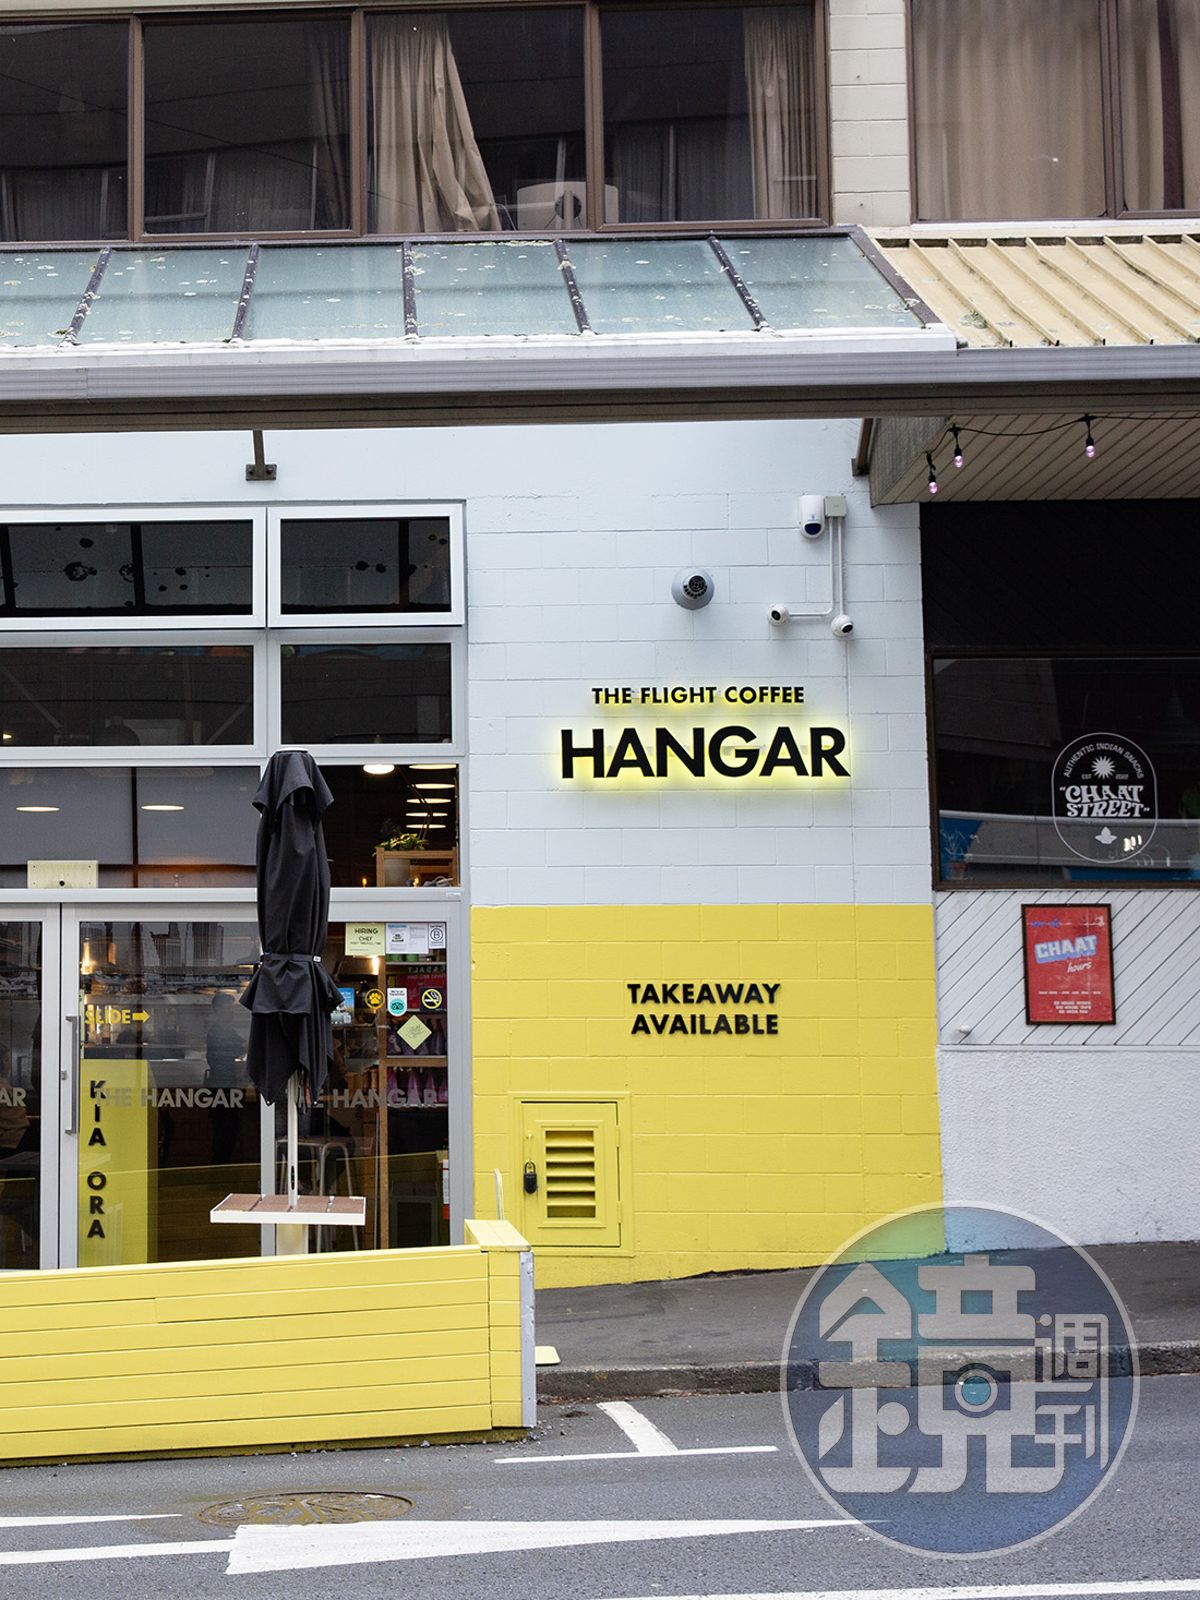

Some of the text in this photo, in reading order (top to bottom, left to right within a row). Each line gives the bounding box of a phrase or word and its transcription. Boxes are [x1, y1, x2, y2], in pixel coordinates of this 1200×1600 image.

[591, 685, 805, 704] THE FLIGHT COFFEE
[561, 725, 851, 779] HANGAR
[1063, 742, 1145, 779] AUTHENTIC INDIAN SNACKS
[354, 927, 379, 935] HIRING
[1036, 935, 1097, 960] CHAAT
[1066, 961, 1092, 973] hours
[627, 983, 781, 1005] TAKEAWAY
[85, 1008, 131, 1025] SLIDE
[631, 1013, 780, 1035] AVAILABLE
[95, 1087, 244, 1108] THE HANGAR
[333, 1088, 438, 1109] HANGAR
[86, 1080, 108, 1239] KIA ORA
